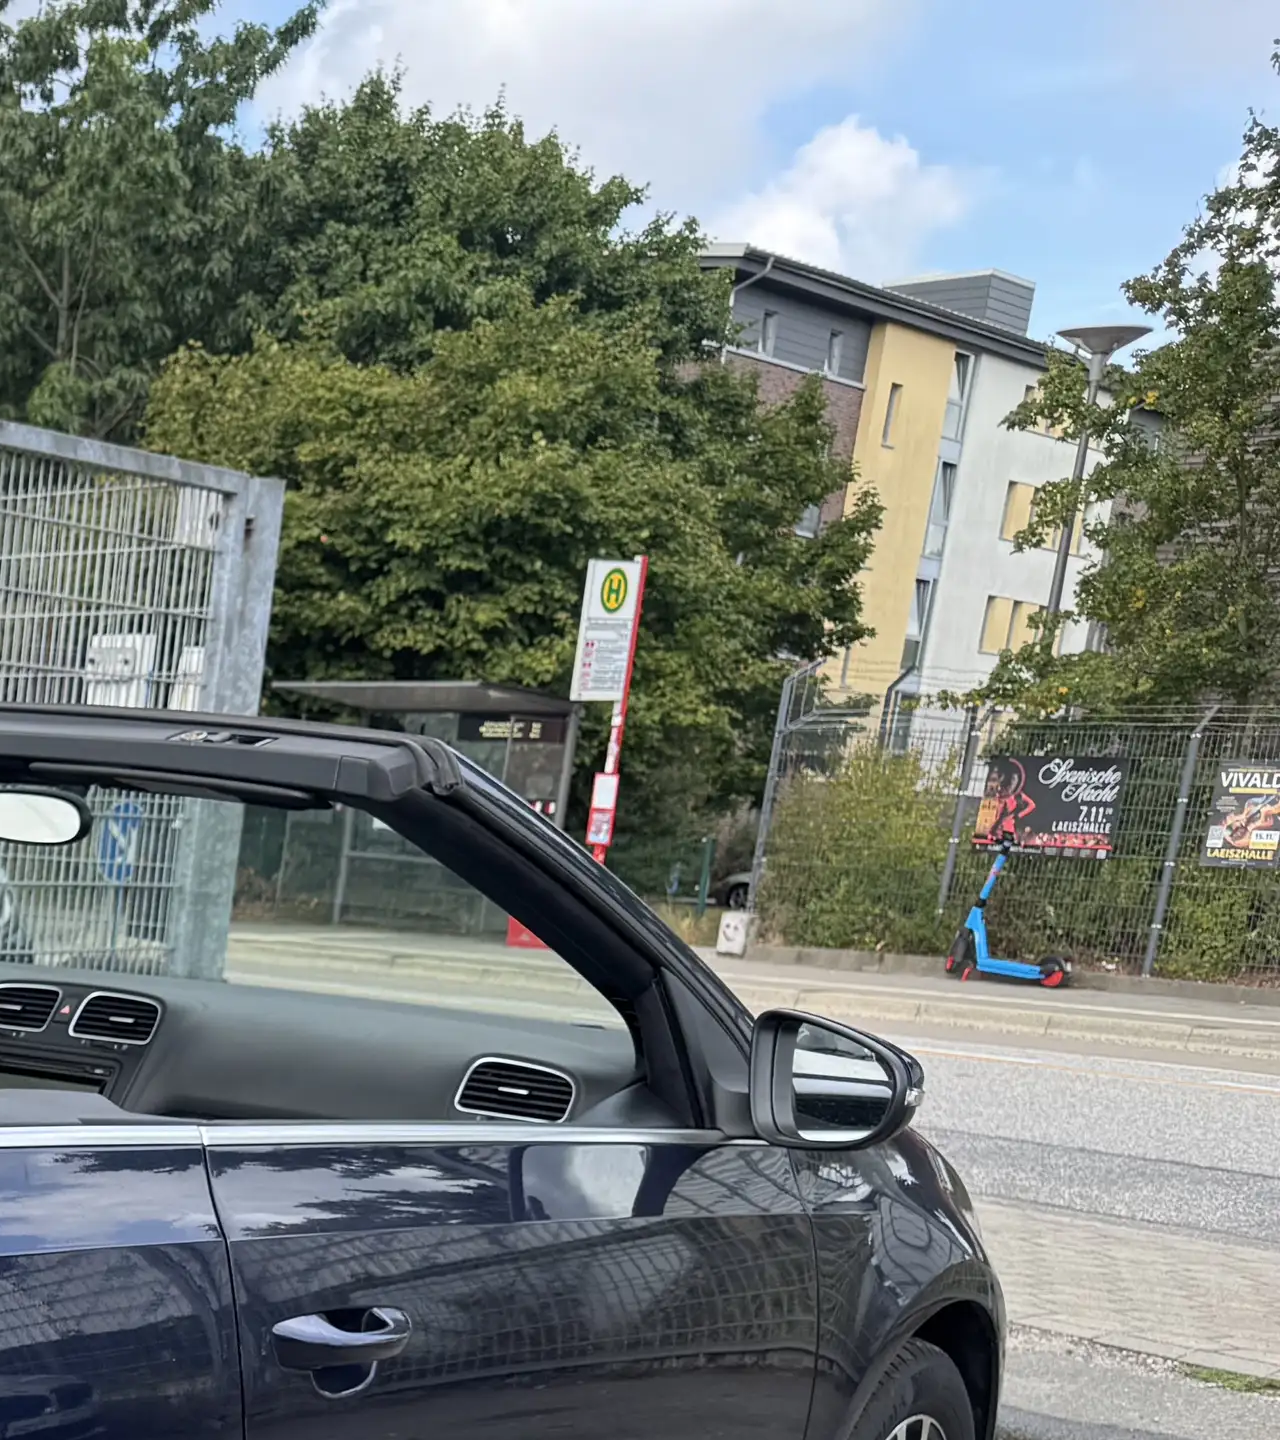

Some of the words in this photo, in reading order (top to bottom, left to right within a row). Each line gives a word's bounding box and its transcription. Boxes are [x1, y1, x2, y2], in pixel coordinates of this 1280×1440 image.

[1038, 758, 1122, 789] Spanische
[1061, 783, 1120, 803] Nacht
[1207, 848, 1274, 860] LAEISZHALLE
